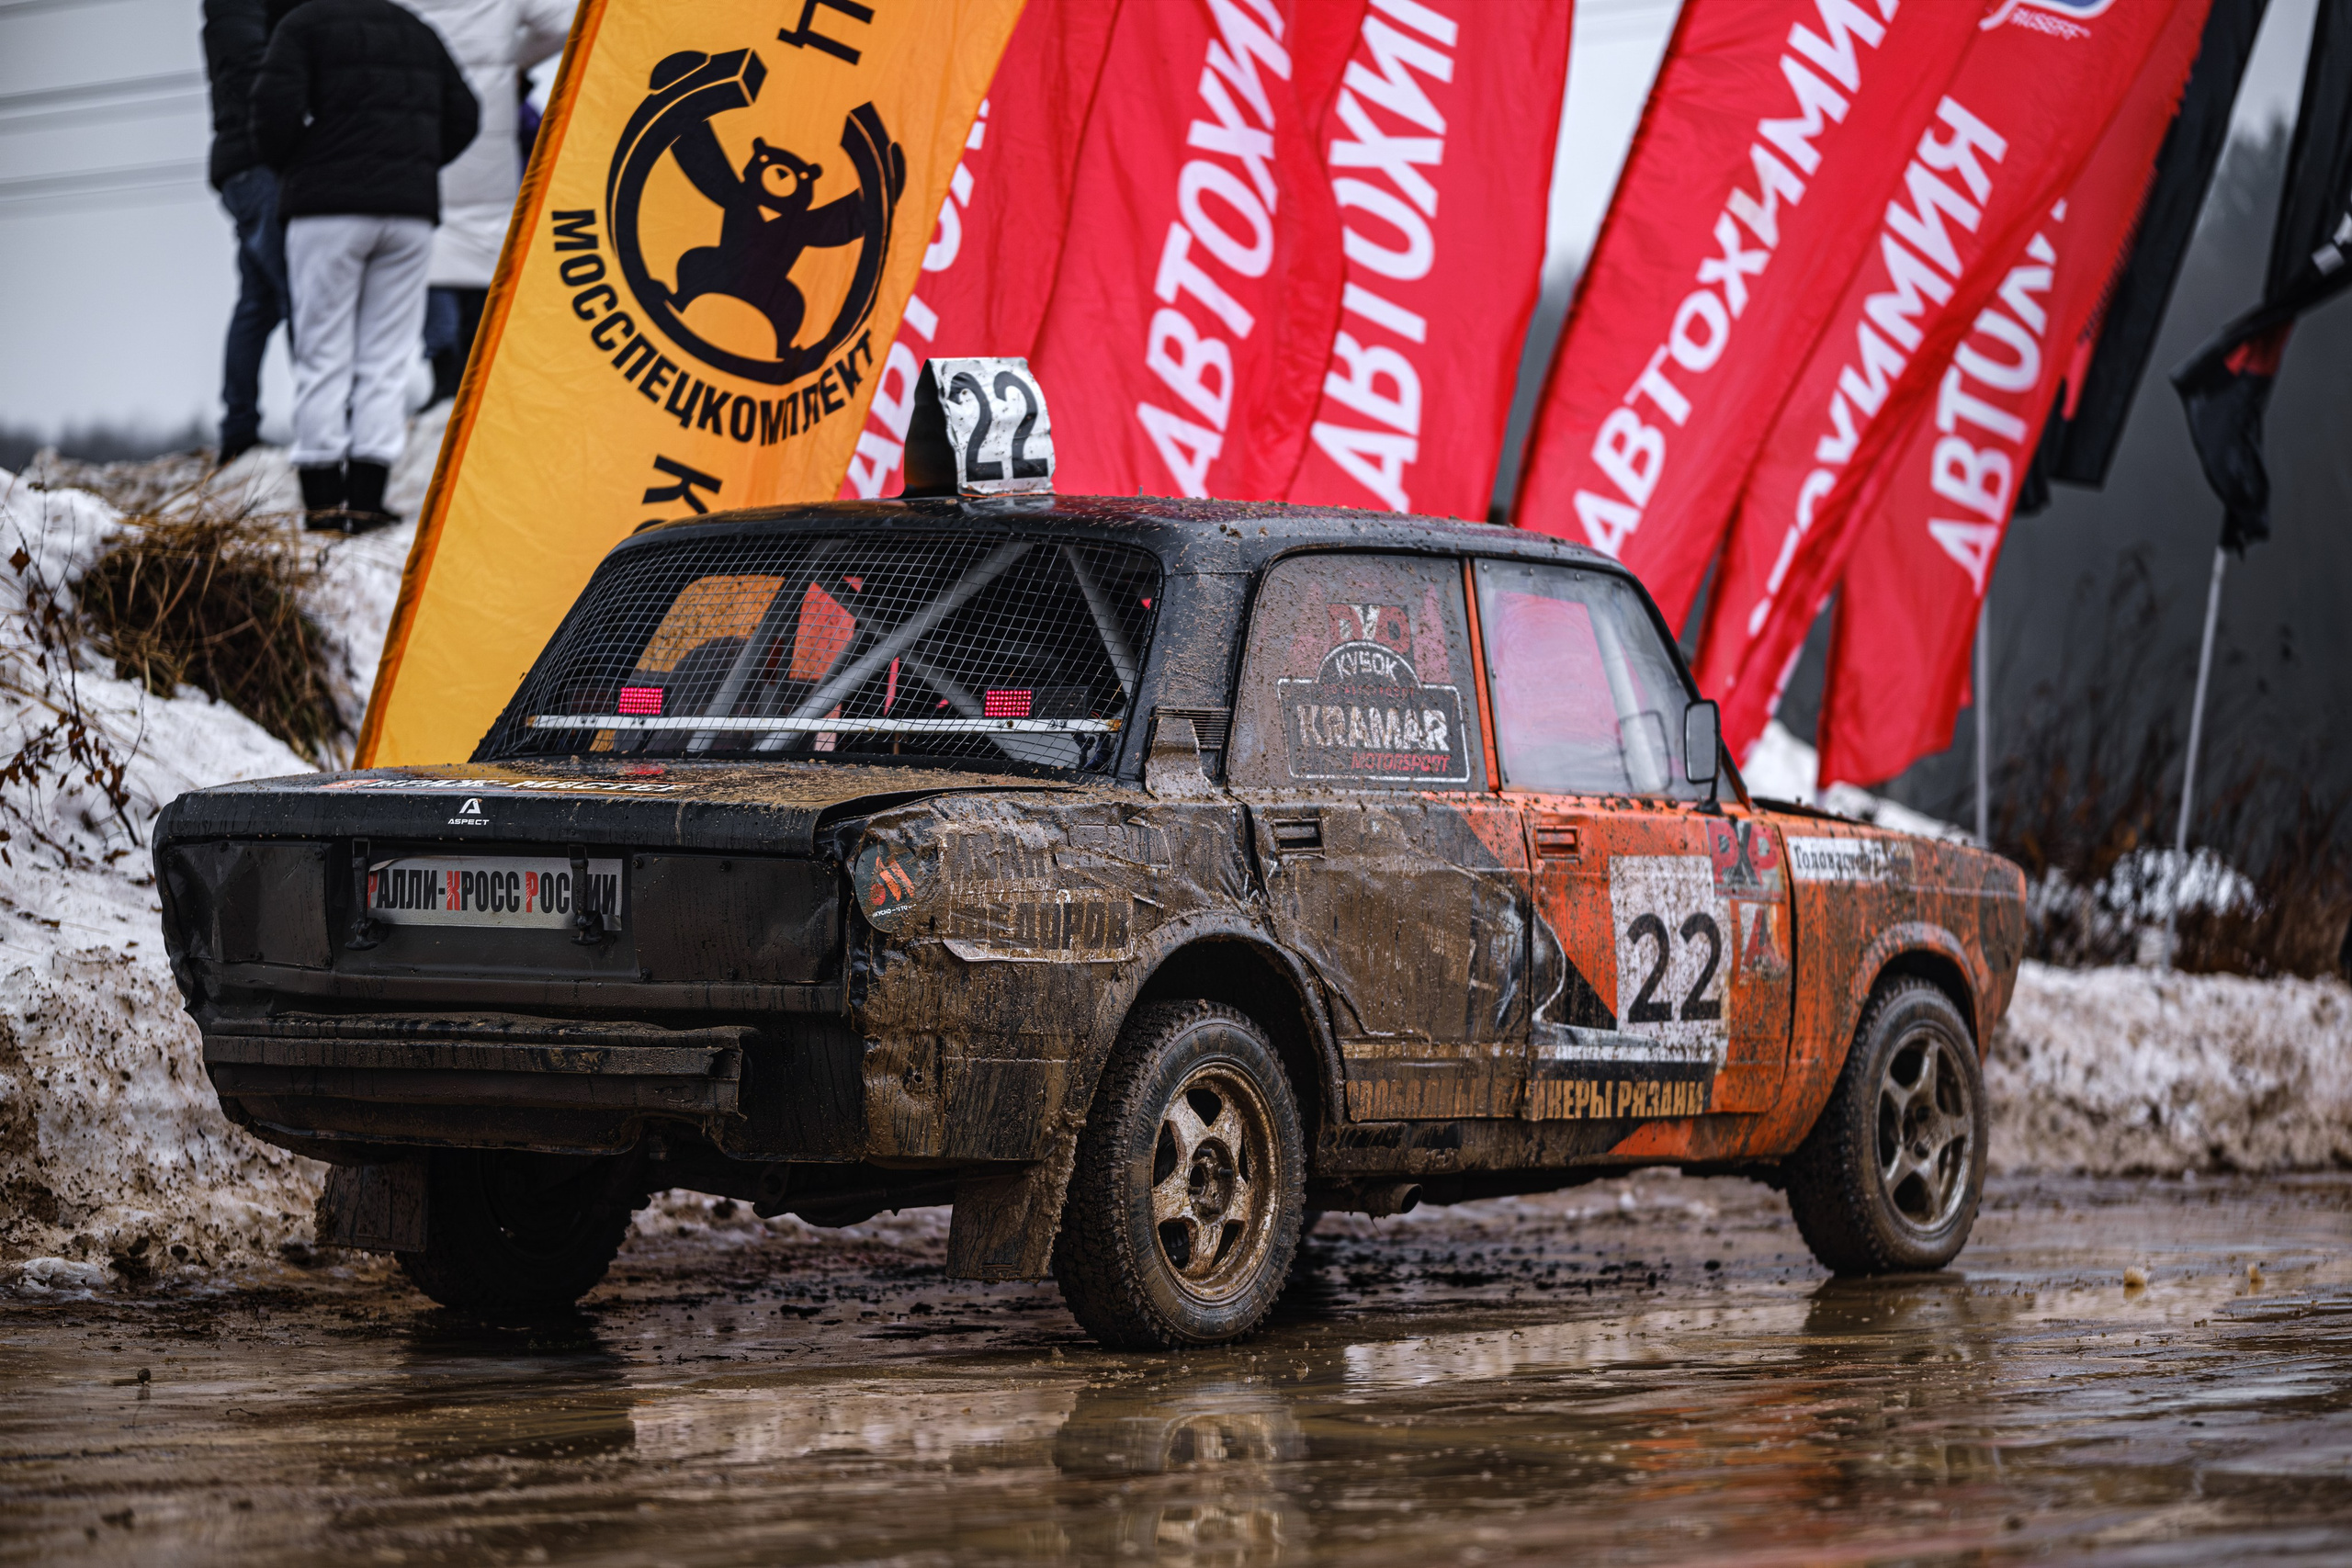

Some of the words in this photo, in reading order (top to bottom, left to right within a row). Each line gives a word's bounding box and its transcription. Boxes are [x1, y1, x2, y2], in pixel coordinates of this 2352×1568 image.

[551, 209, 875, 447] МОССПЕЦКОМПЛЕКТ
[1572, 0, 1900, 561] АВТОХИМИ
[946, 370, 1049, 482] 22
[1296, 705, 1450, 751] KRAMAR
[368, 869, 520, 913] РАЛЛИ-КРОСС
[526, 871, 617, 917] РОСИИ
[1626, 912, 1724, 1024] 22
[1617, 1080, 1705, 1118] РЯЗАНИ
